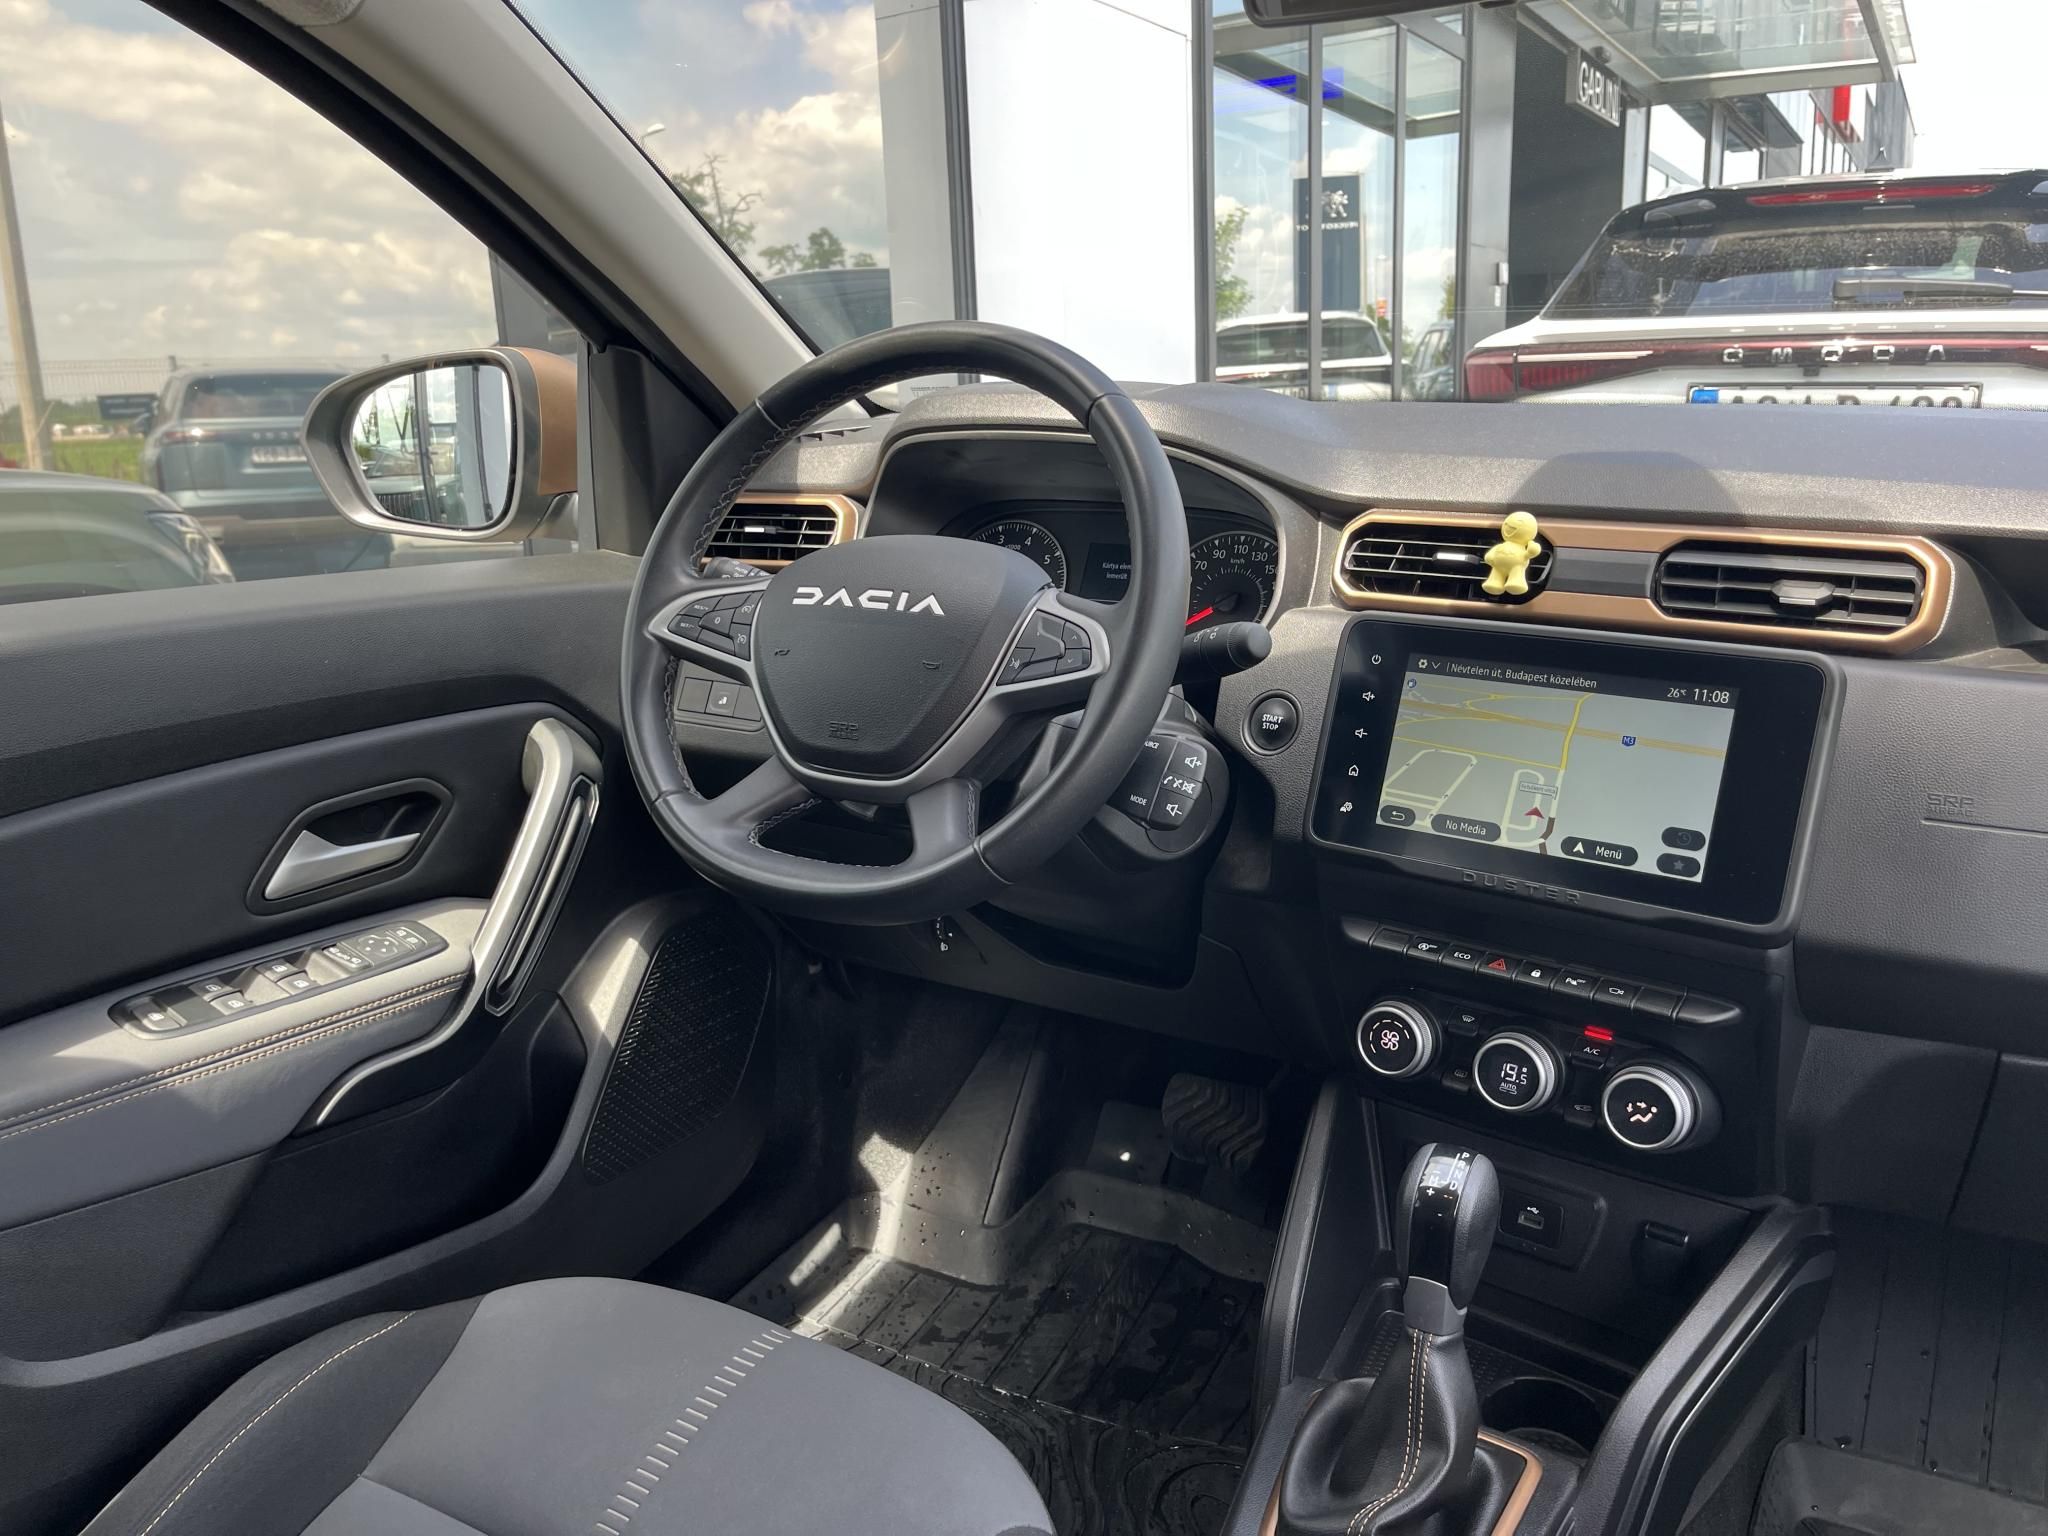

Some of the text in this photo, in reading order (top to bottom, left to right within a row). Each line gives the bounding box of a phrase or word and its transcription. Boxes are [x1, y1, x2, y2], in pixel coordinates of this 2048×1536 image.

[998, 534, 1005, 544] 3
[1024, 536, 1032, 546] 4
[1212, 549, 1226, 559] 90
[1233, 544, 1249, 554] 110
[1043, 554, 1051, 565] 5
[1251, 551, 1268, 562] 130
[1195, 560, 1208, 571] 70
[792, 586, 945, 616] DACIA
[1451, 663, 1490, 677] Névtelen
[1505, 669, 1547, 684] Budapest
[1550, 673, 1597, 689] közelében
[1694, 688, 1730, 704] 11:08
[1262, 713, 1284, 724] START
[1262, 722, 1279, 731] STOP
[1130, 794, 1148, 806] MODE
[1445, 819, 1487, 836] No Media
[1595, 845, 1622, 860] Menü
[1462, 870, 1581, 905] DUSTER
[1453, 950, 1471, 960] ECO
[1584, 1046, 1601, 1056] A/C
[1501, 1081, 1517, 1091] AUTO
[1461, 1151, 1470, 1159] P
[1449, 1180, 1458, 1191] D
